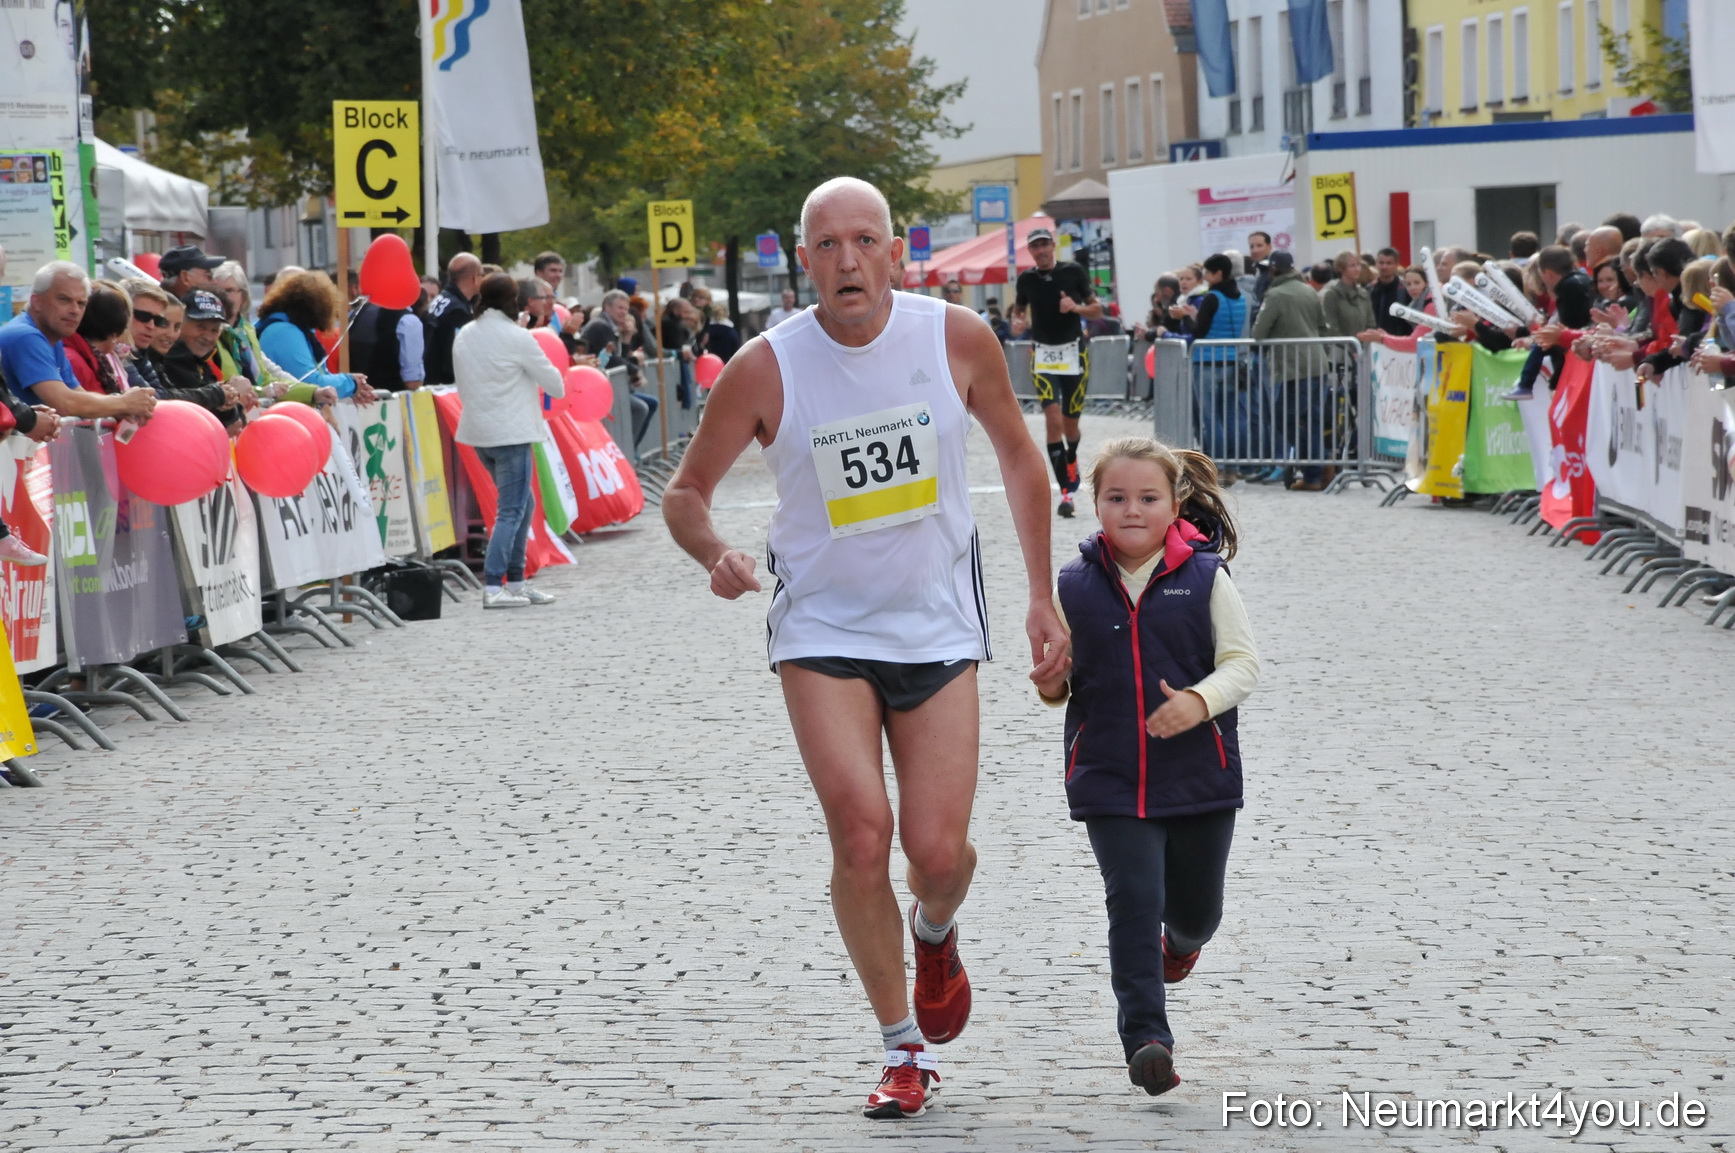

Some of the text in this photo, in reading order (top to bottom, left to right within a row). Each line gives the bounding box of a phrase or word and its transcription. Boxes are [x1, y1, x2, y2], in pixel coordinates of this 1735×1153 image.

[345, 107, 408, 128] Block
[470, 146, 531, 160] neumarkt
[356, 139, 398, 200] C
[1316, 176, 1350, 190] Block
[654, 204, 687, 216] Block
[1325, 194, 1347, 225] D
[661, 222, 682, 252] D
[813, 418, 913, 448] PARTL Neumarkt
[840, 435, 920, 489] 534
